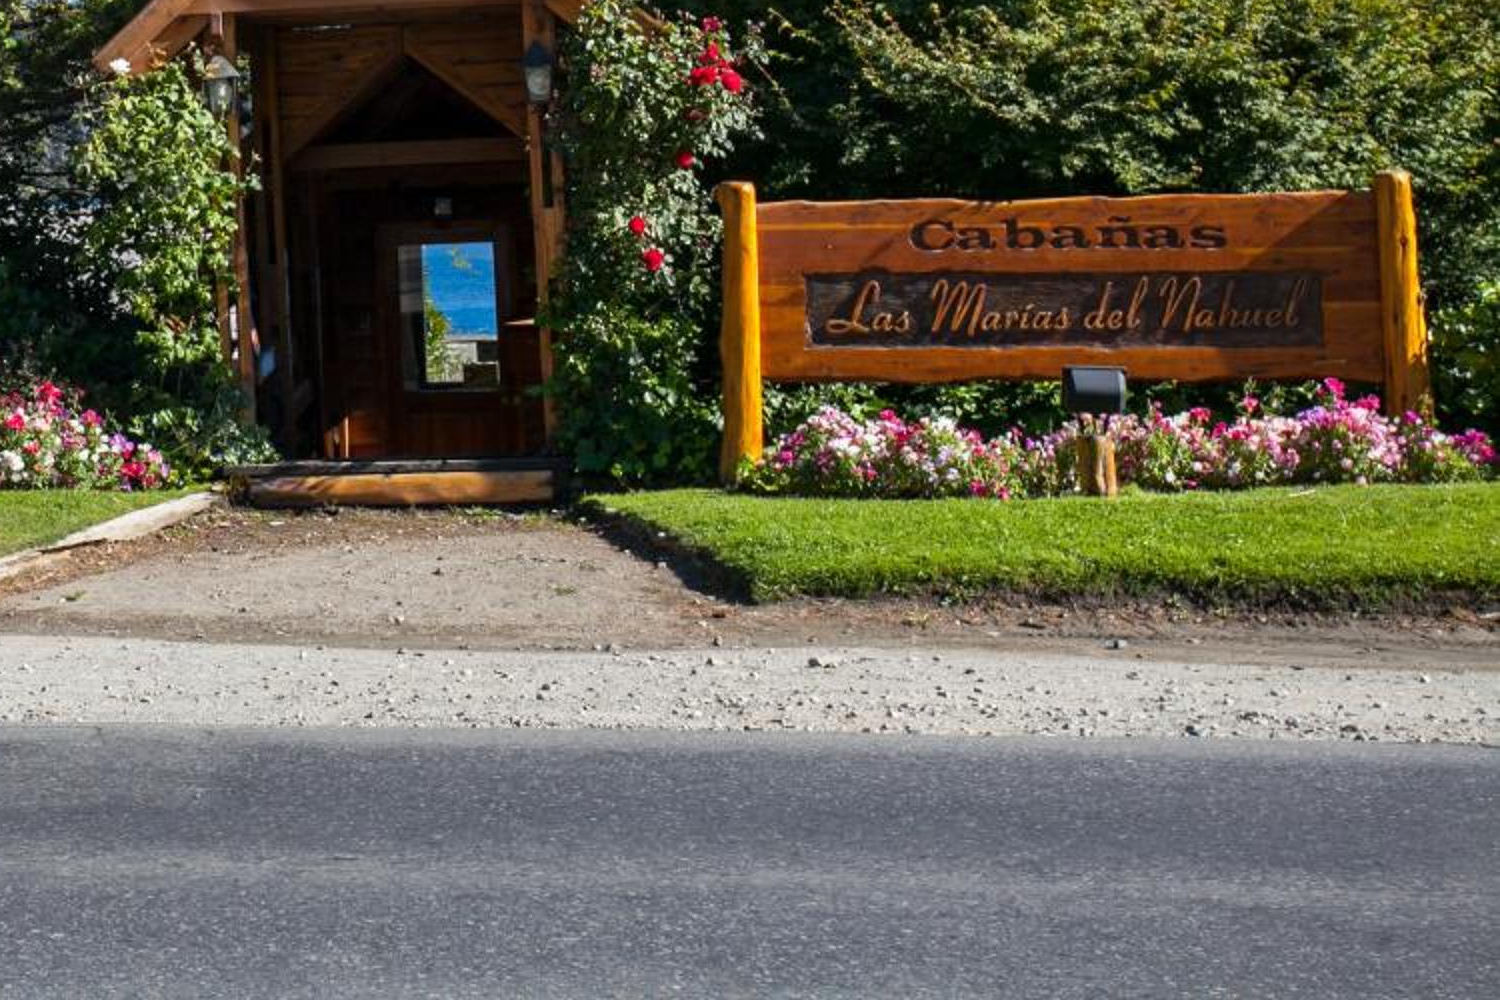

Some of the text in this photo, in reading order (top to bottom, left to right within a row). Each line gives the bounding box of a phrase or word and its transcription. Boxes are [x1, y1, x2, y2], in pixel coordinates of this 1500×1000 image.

[908, 216, 1228, 252] Cabañas
[825, 275, 1308, 337] Las Marías del Nahuel
